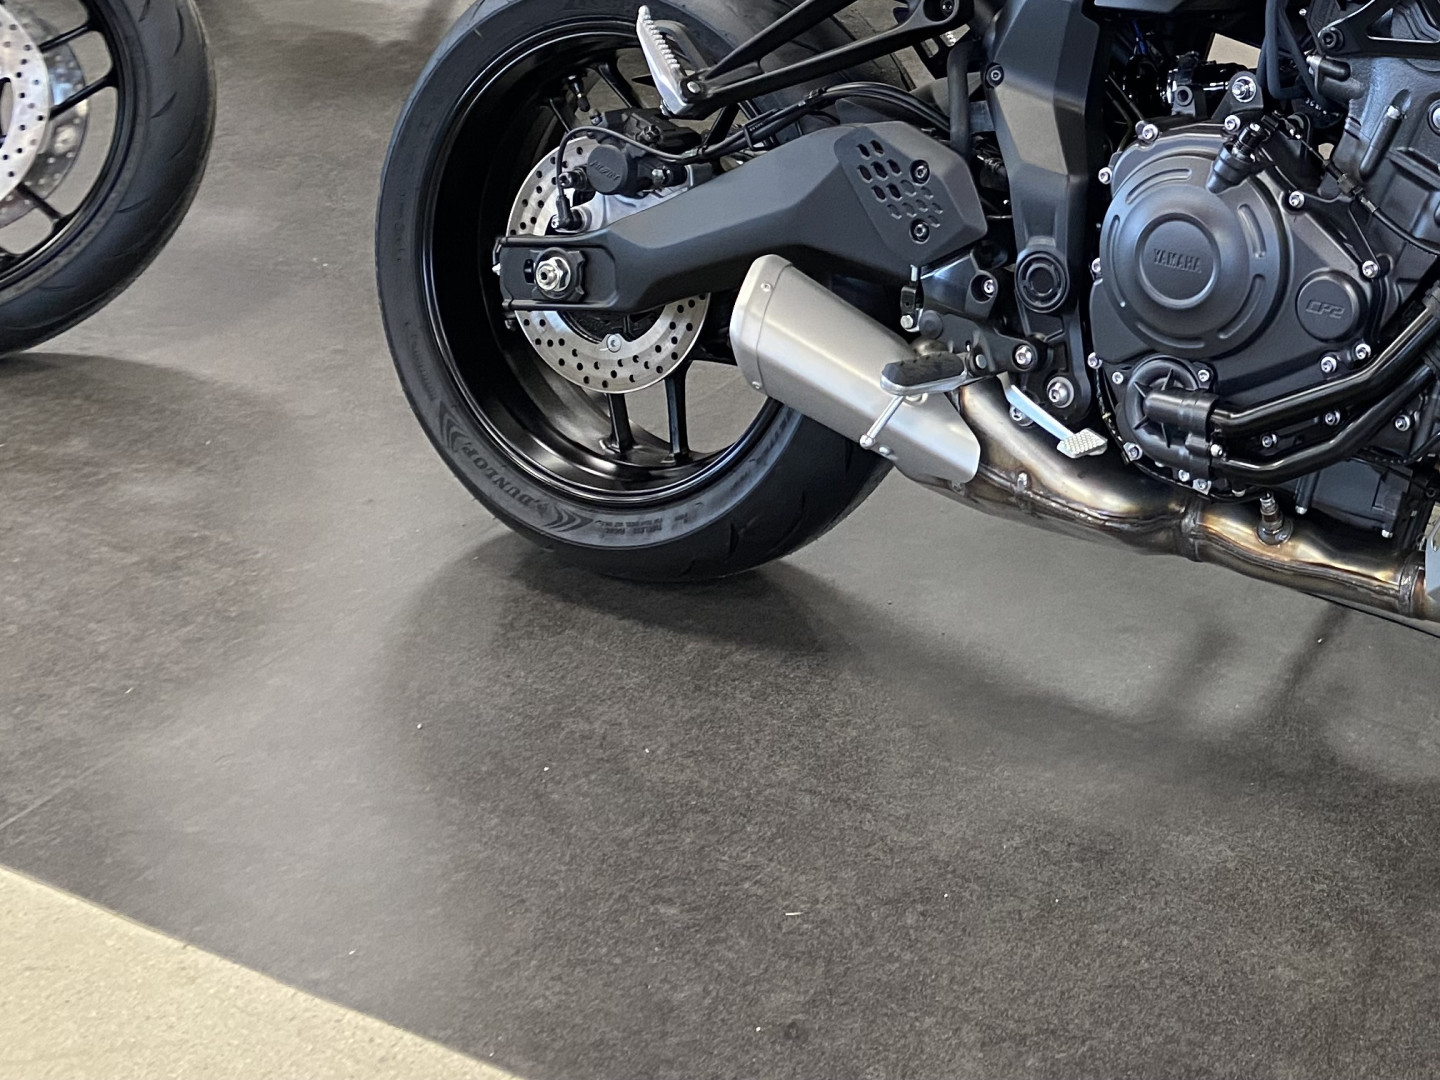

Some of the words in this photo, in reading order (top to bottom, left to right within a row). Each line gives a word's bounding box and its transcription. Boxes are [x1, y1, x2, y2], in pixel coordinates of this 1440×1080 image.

[1153, 248, 1202, 273] YAMAHA
[1306, 299, 1345, 319] CP2
[461, 442, 535, 507] DUNLOP
